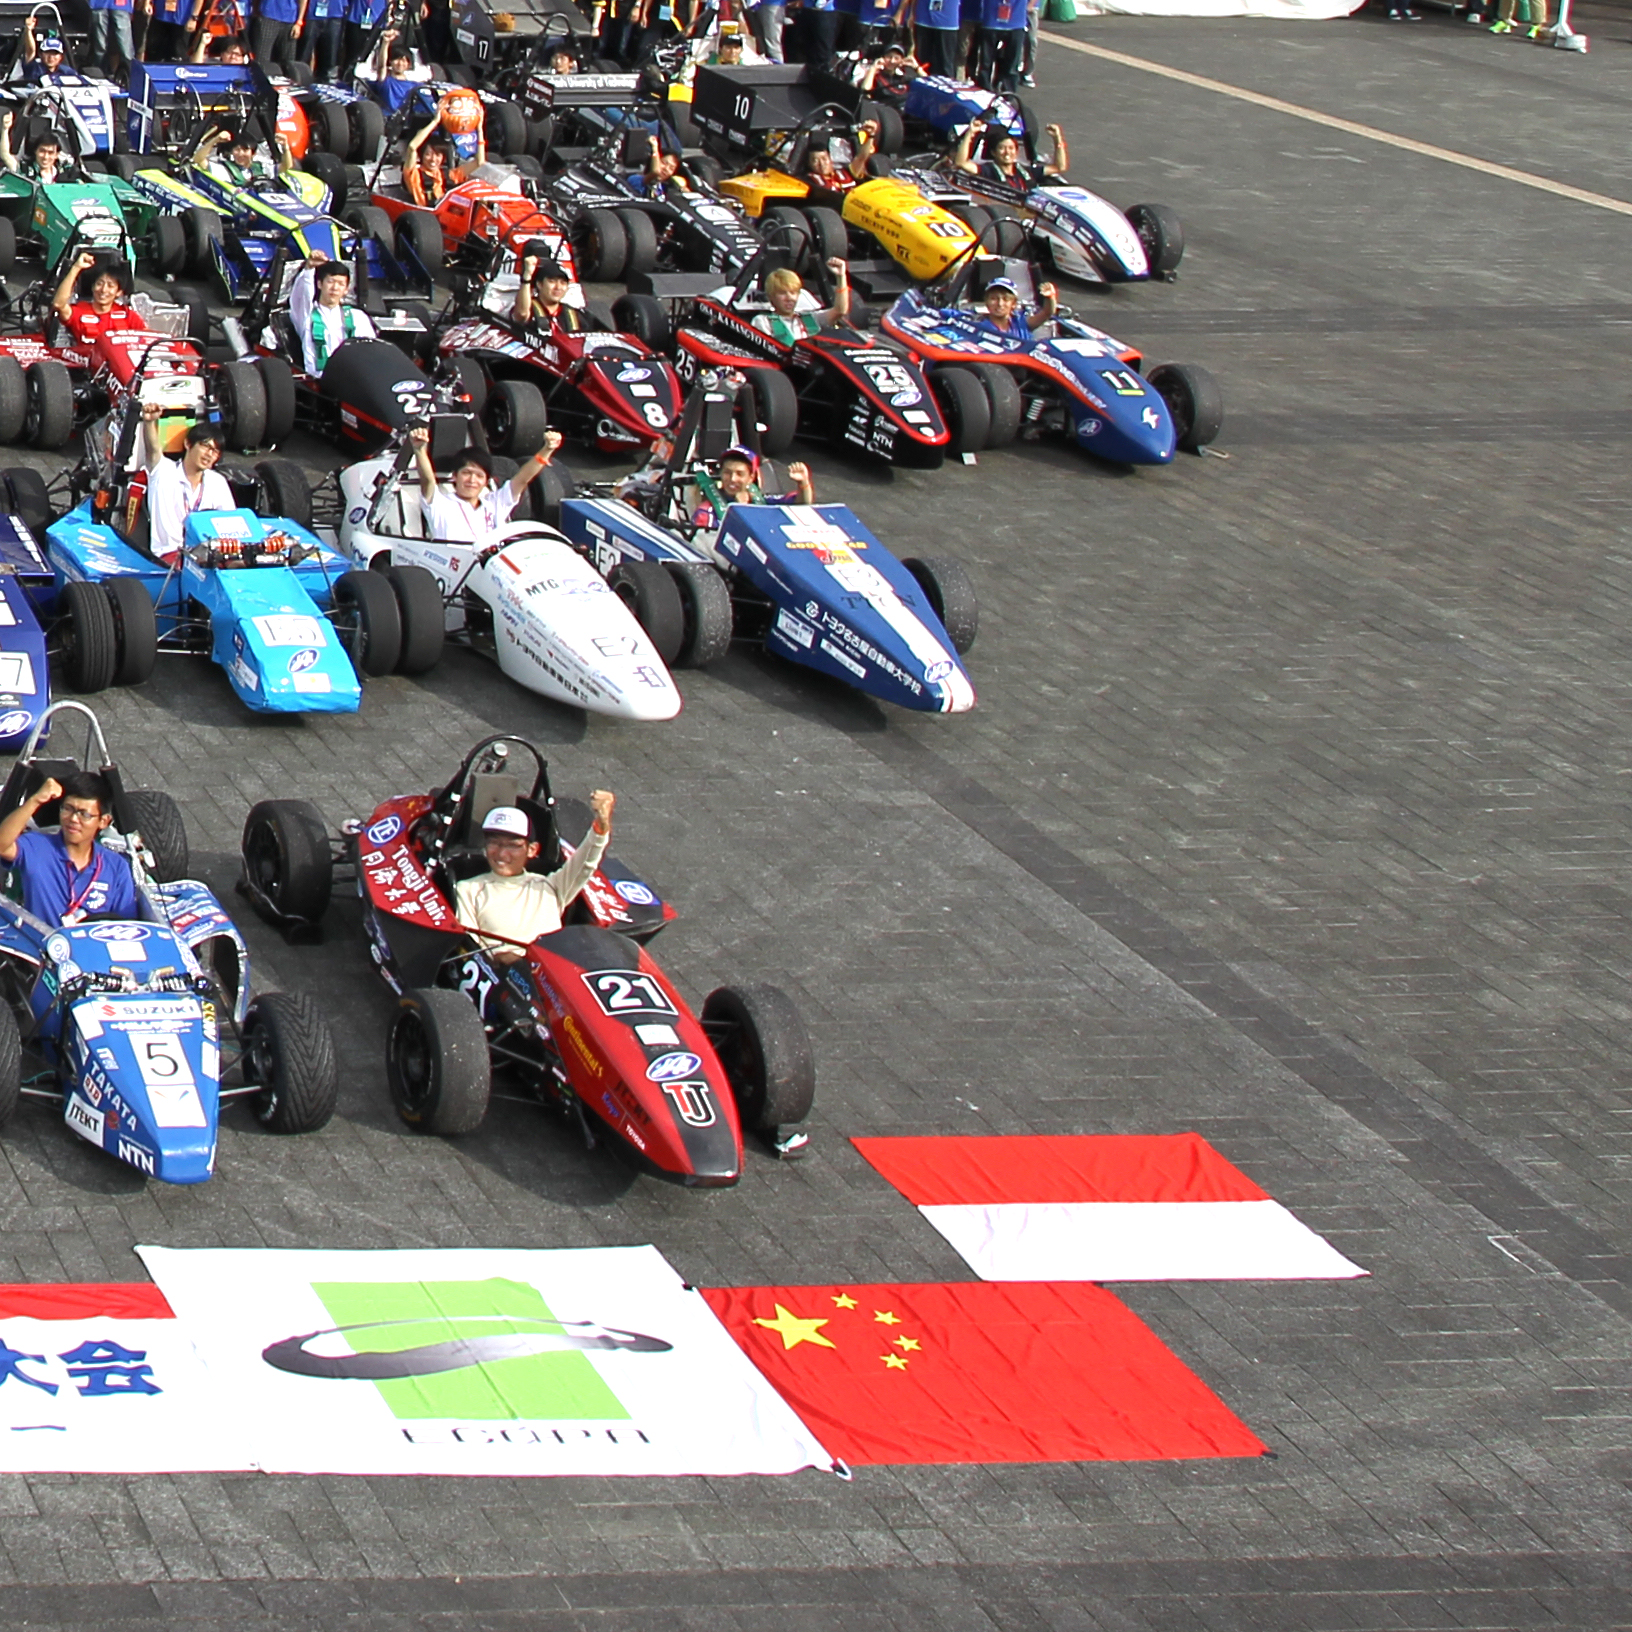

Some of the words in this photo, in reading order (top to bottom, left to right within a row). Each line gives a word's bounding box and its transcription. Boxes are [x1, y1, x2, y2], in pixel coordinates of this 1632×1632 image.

[931, 222, 966, 237] 10
[675, 348, 696, 380] 25
[867, 366, 911, 388] 25
[1101, 370, 1142, 390] 11
[642, 401, 670, 428] 8
[525, 577, 561, 598] MTG
[390, 843, 431, 893] Tongji
[415, 887, 445, 928] Univ.
[597, 975, 668, 1011] 21
[122, 1005, 197, 1017] SUZUKI
[145, 1041, 180, 1077] 5
[90, 1059, 138, 1132] TAKATA
[67, 1101, 100, 1135] JTEKT
[117, 1137, 156, 1177] NTN
